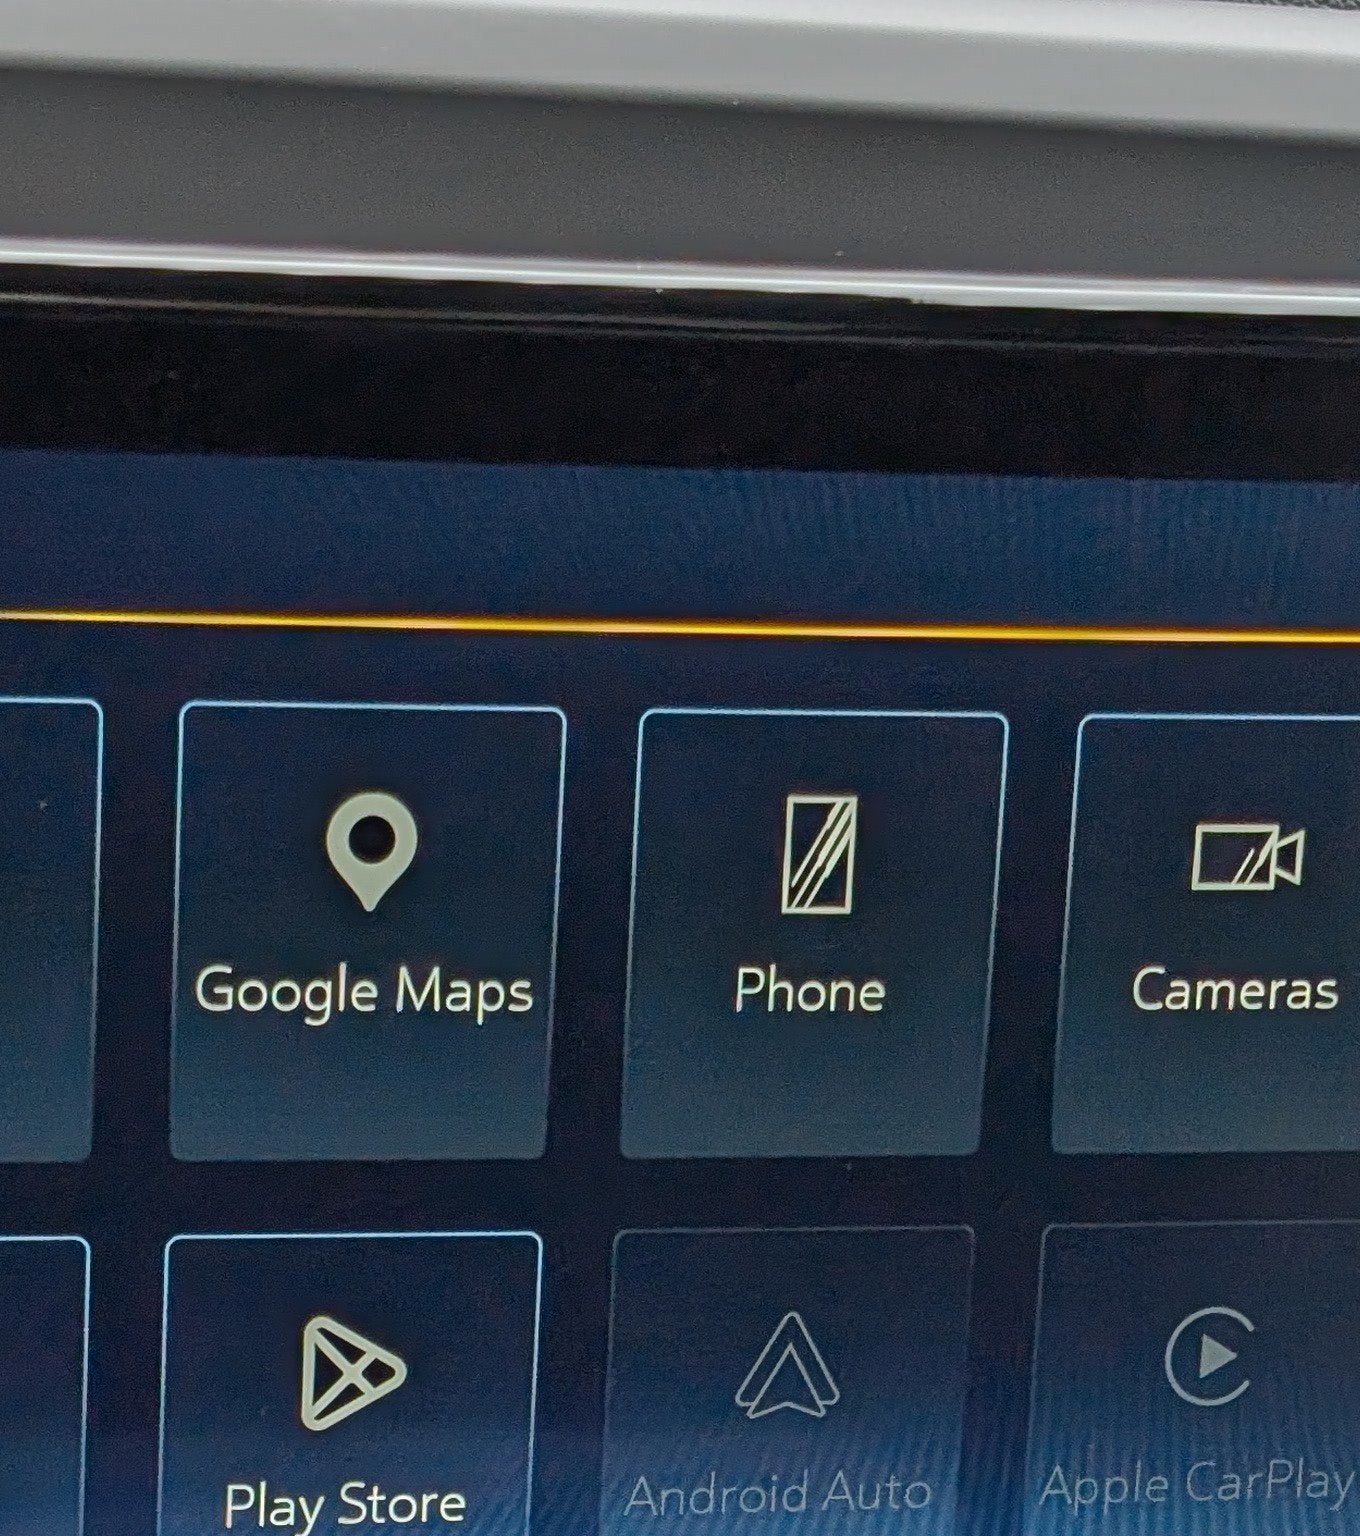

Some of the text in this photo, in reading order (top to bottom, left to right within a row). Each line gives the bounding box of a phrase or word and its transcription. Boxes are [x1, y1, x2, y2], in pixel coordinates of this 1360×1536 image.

[195, 961, 534, 1027] Google Maps
[735, 963, 886, 1013] Phone
[1132, 965, 1339, 1012] Cameras
[337, 1481, 467, 1526] Store
[624, 1468, 932, 1518] Android Auto
[1037, 1456, 1356, 1517] Apple CarPlay
